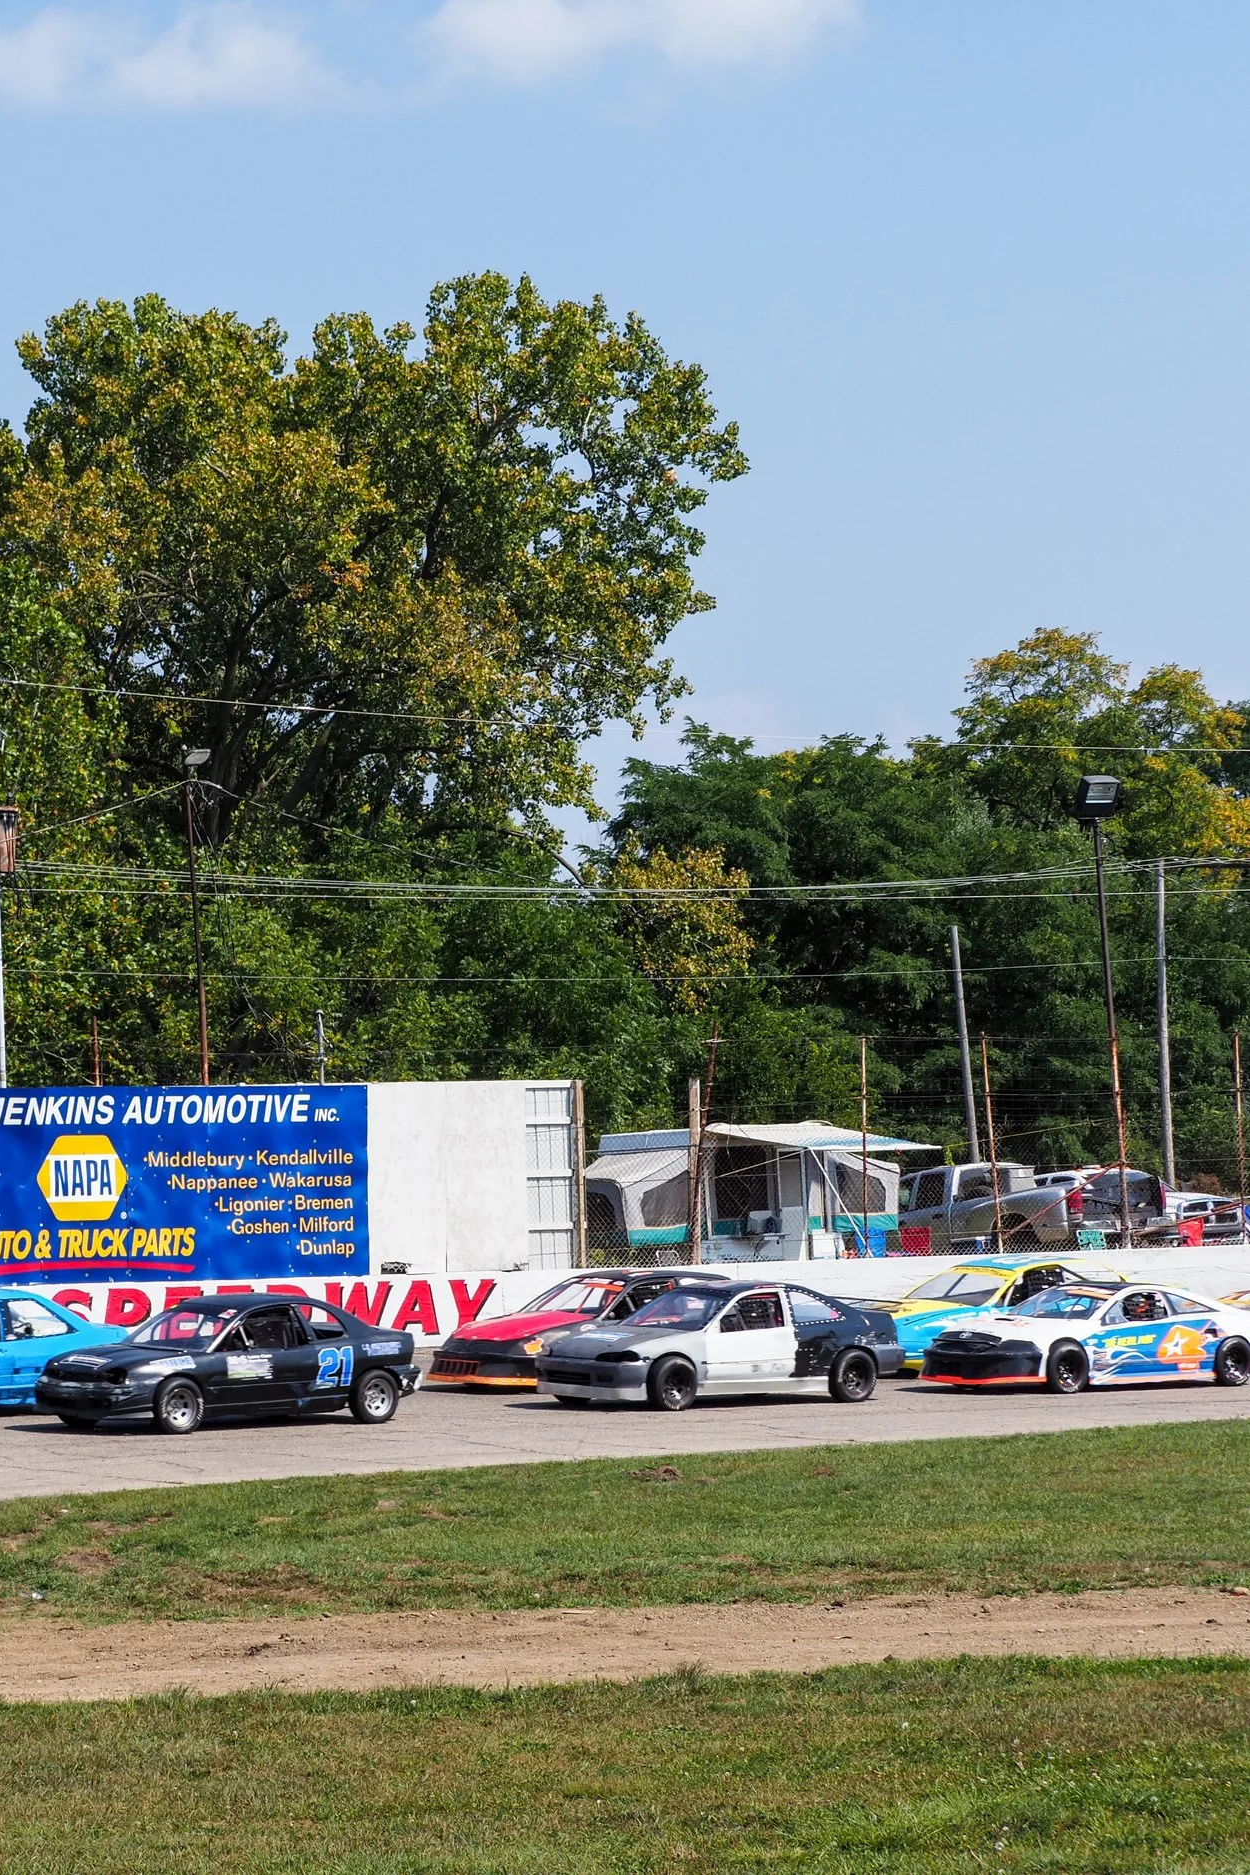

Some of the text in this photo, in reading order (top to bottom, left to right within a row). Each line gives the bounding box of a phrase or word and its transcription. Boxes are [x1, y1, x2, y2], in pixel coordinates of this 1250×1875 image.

[122, 1094, 311, 1125] AUTOMOTIVE
[314, 1108, 341, 1122] INC.
[146, 1149, 354, 1169] Middlebury Kendallville
[54, 1159, 113, 1198] NAPA
[171, 1172, 353, 1193] Nappanee Wakarusa
[219, 1194, 354, 1216] Ligonier Bremen
[231, 1215, 354, 1235] Goshen Milford
[34, 1229, 51, 1259] &
[58, 1228, 130, 1259] TRUCK
[131, 1226, 197, 1258] PARTS
[300, 1238, 356, 1259] Dunlap
[316, 1345, 354, 1388] 21
